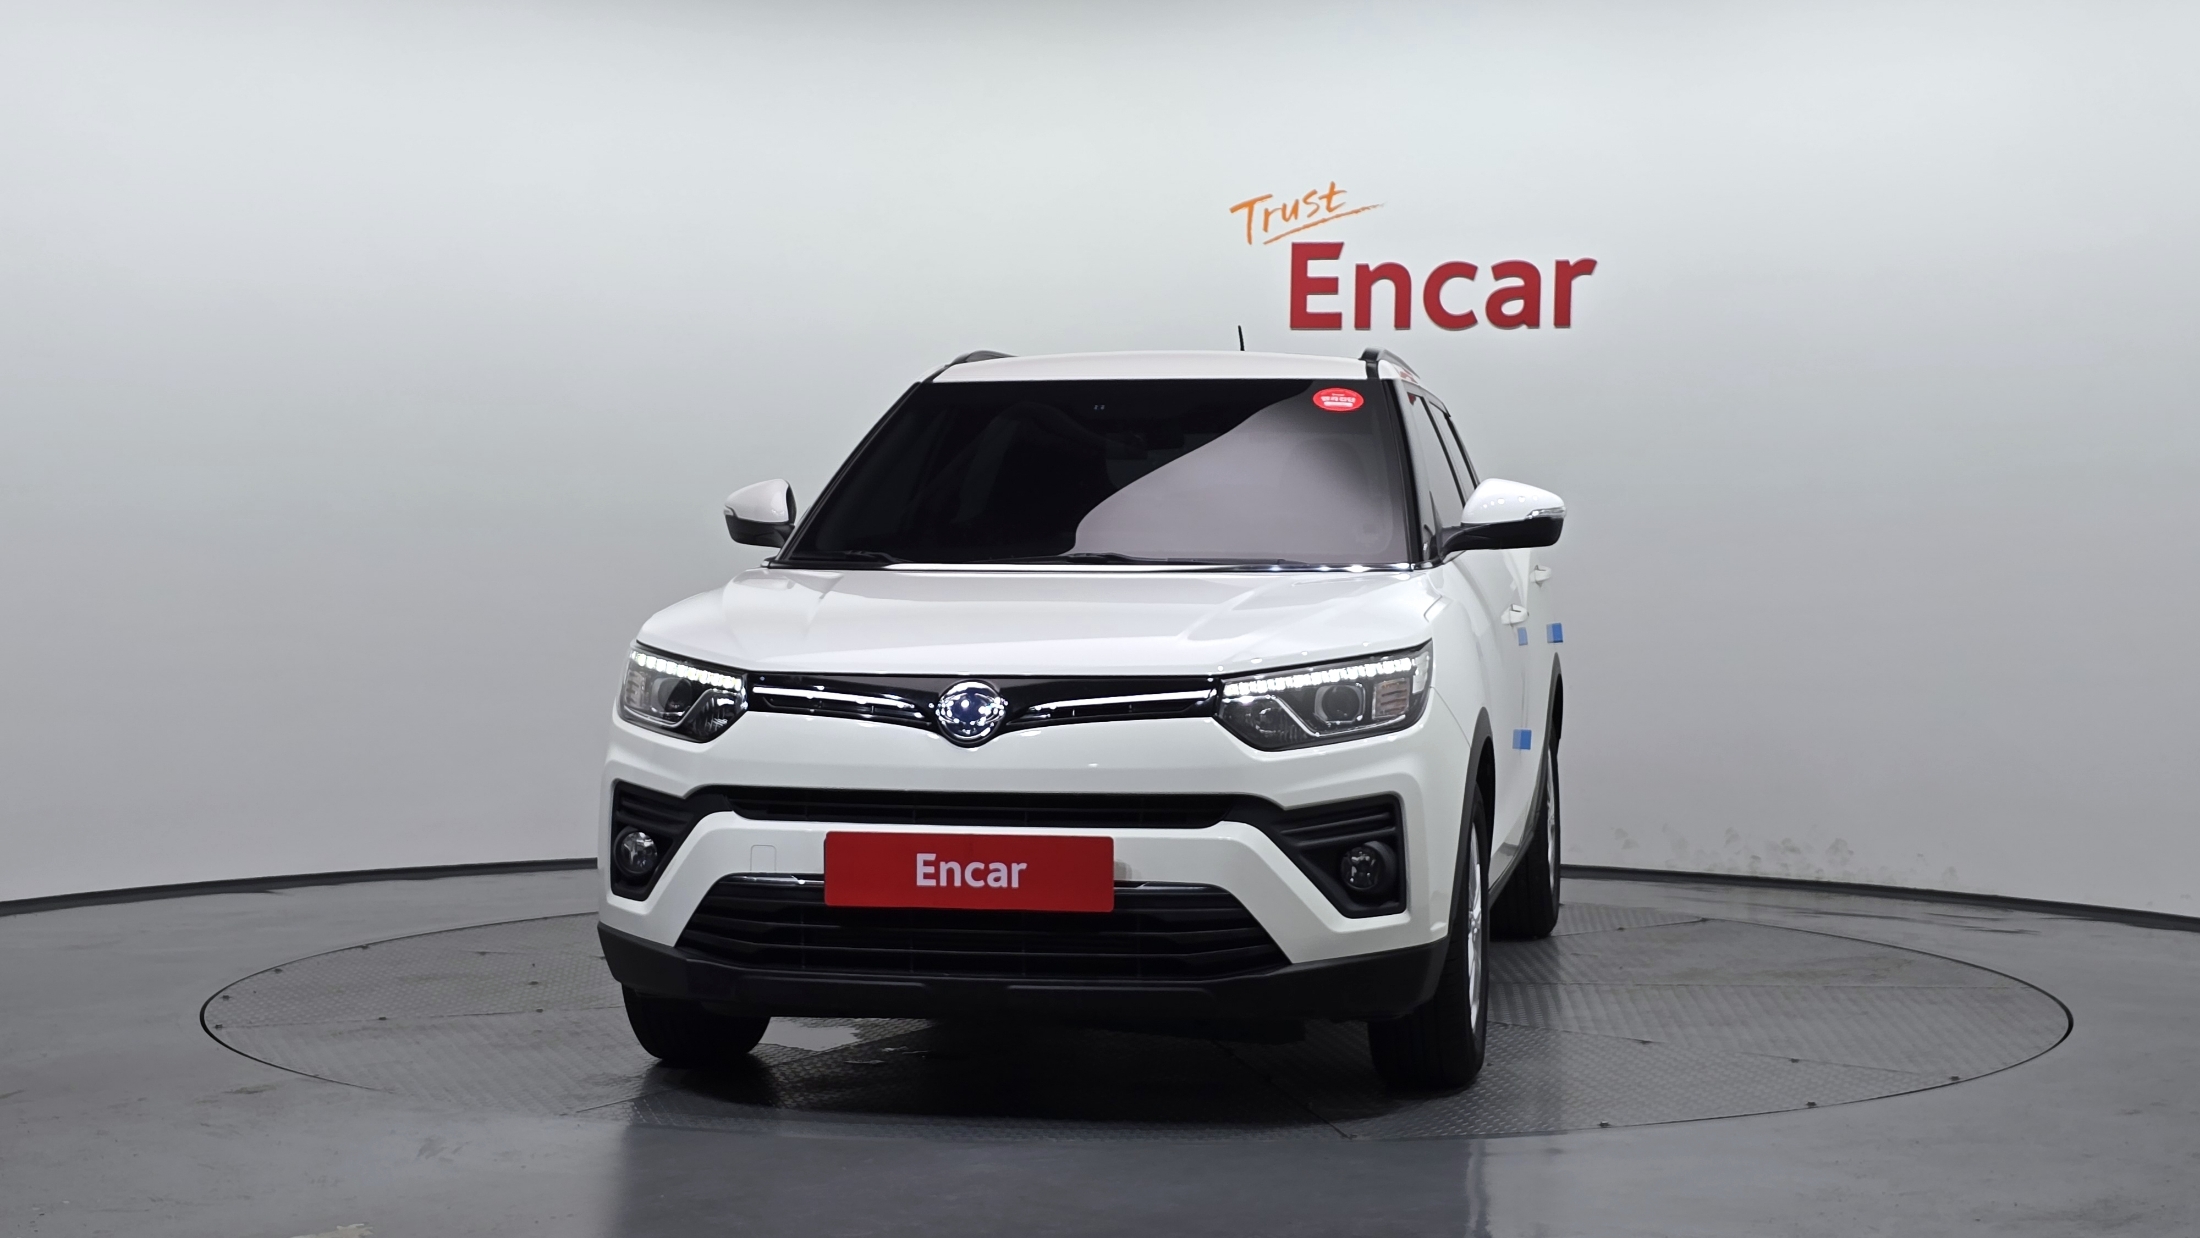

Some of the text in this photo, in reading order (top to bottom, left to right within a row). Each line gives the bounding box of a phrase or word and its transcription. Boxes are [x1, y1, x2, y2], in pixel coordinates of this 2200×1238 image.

[1230, 181, 1347, 245] Trust
[1290, 241, 1598, 331] Encar
[916, 853, 1028, 889] Encar
